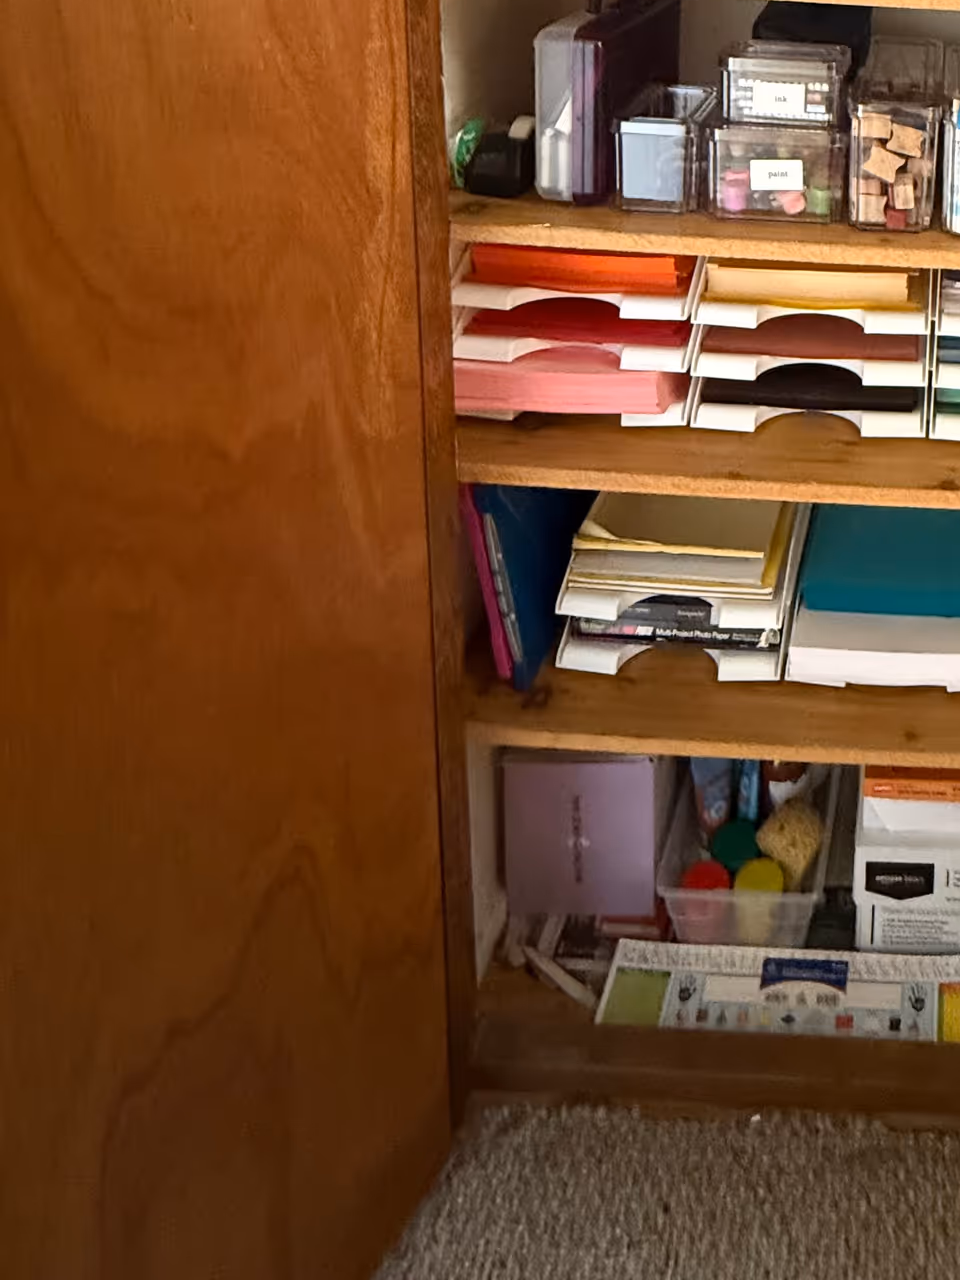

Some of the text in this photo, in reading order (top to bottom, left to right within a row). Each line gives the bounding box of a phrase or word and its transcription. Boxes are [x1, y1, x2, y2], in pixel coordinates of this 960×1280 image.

[768, 170, 788, 180] paint
[655, 627, 694, 638] Multi-Project
[694, 628, 712, 639] Photo
[712, 630, 731, 641] Paper
